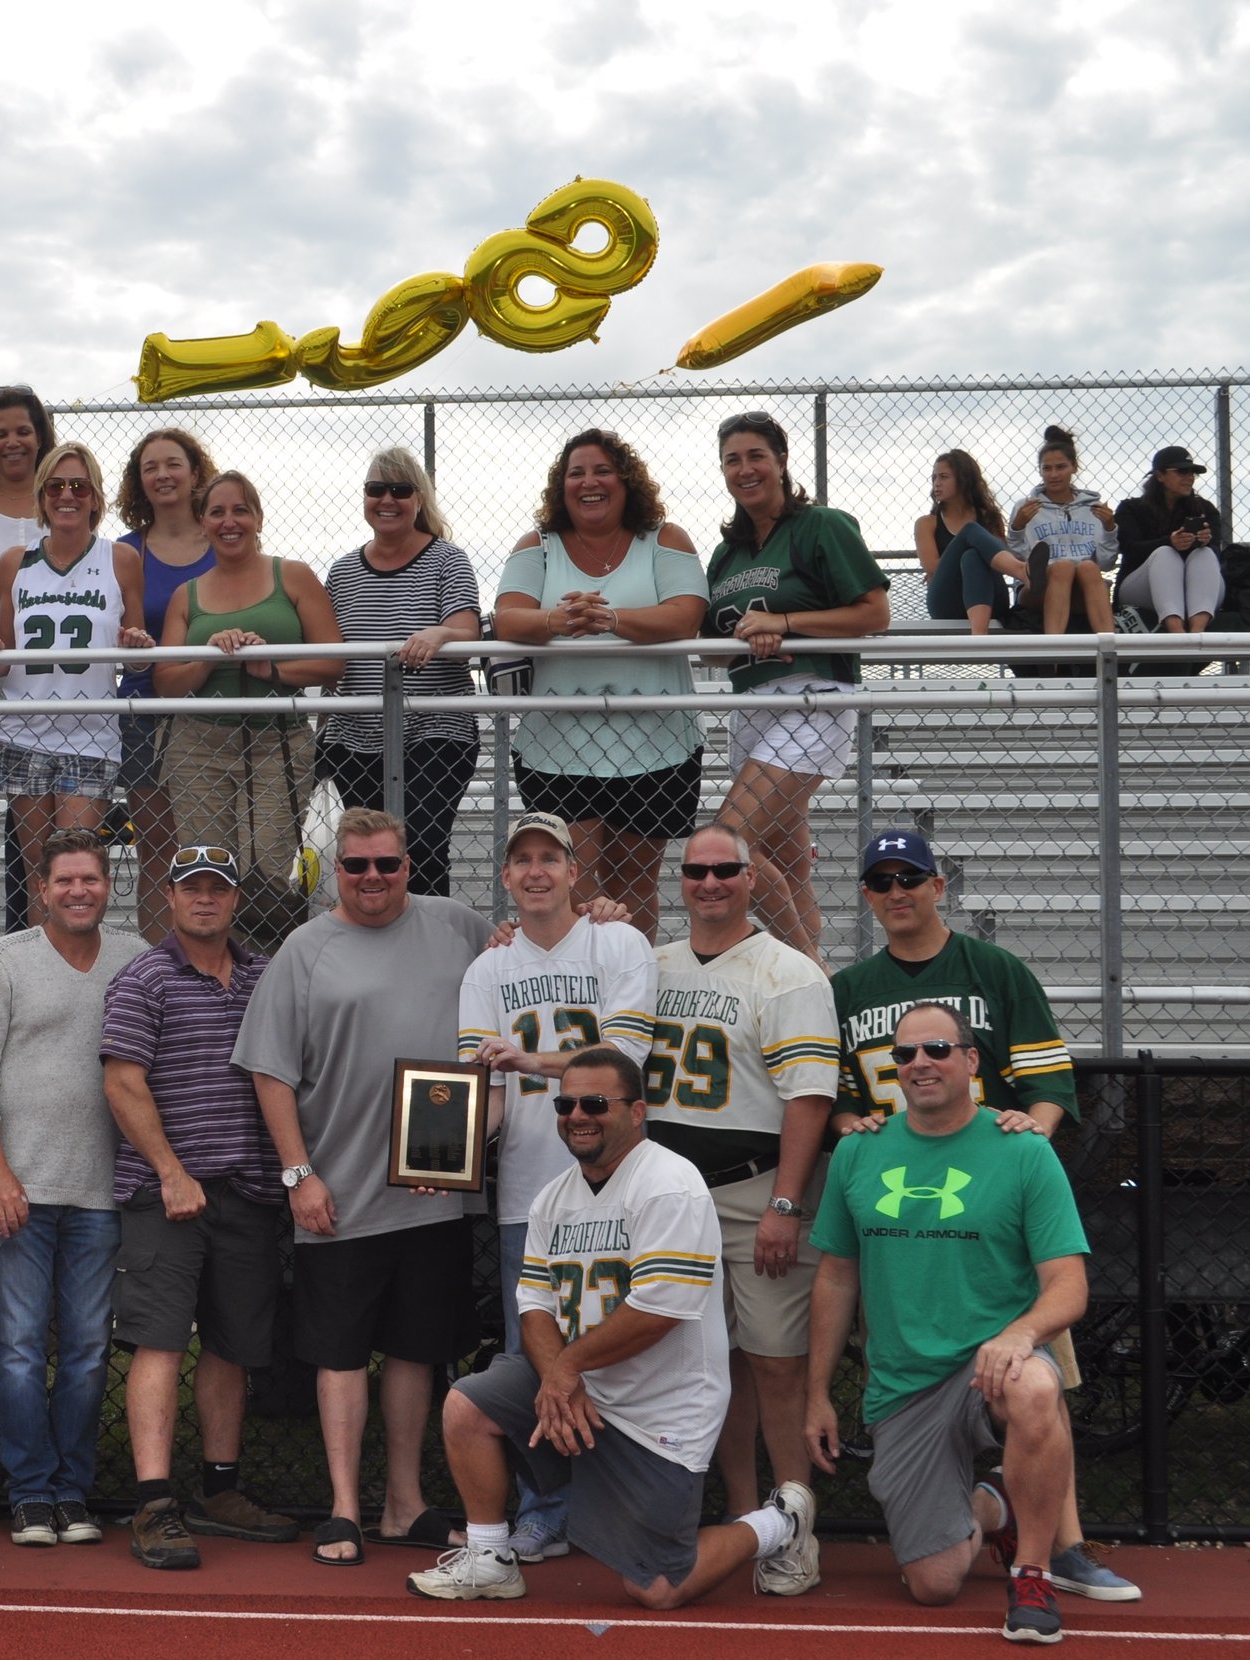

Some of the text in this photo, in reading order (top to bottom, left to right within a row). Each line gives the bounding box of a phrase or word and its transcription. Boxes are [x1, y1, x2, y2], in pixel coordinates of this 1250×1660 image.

[1034, 520, 1095, 540] DELAWARE
[18, 587, 107, 612] Harborfields
[23, 614, 93, 675] 23
[642, 1021, 732, 1122] 69
[862, 1227, 980, 1241] UNDER ARMOUR
[549, 1257, 631, 1345] 33
